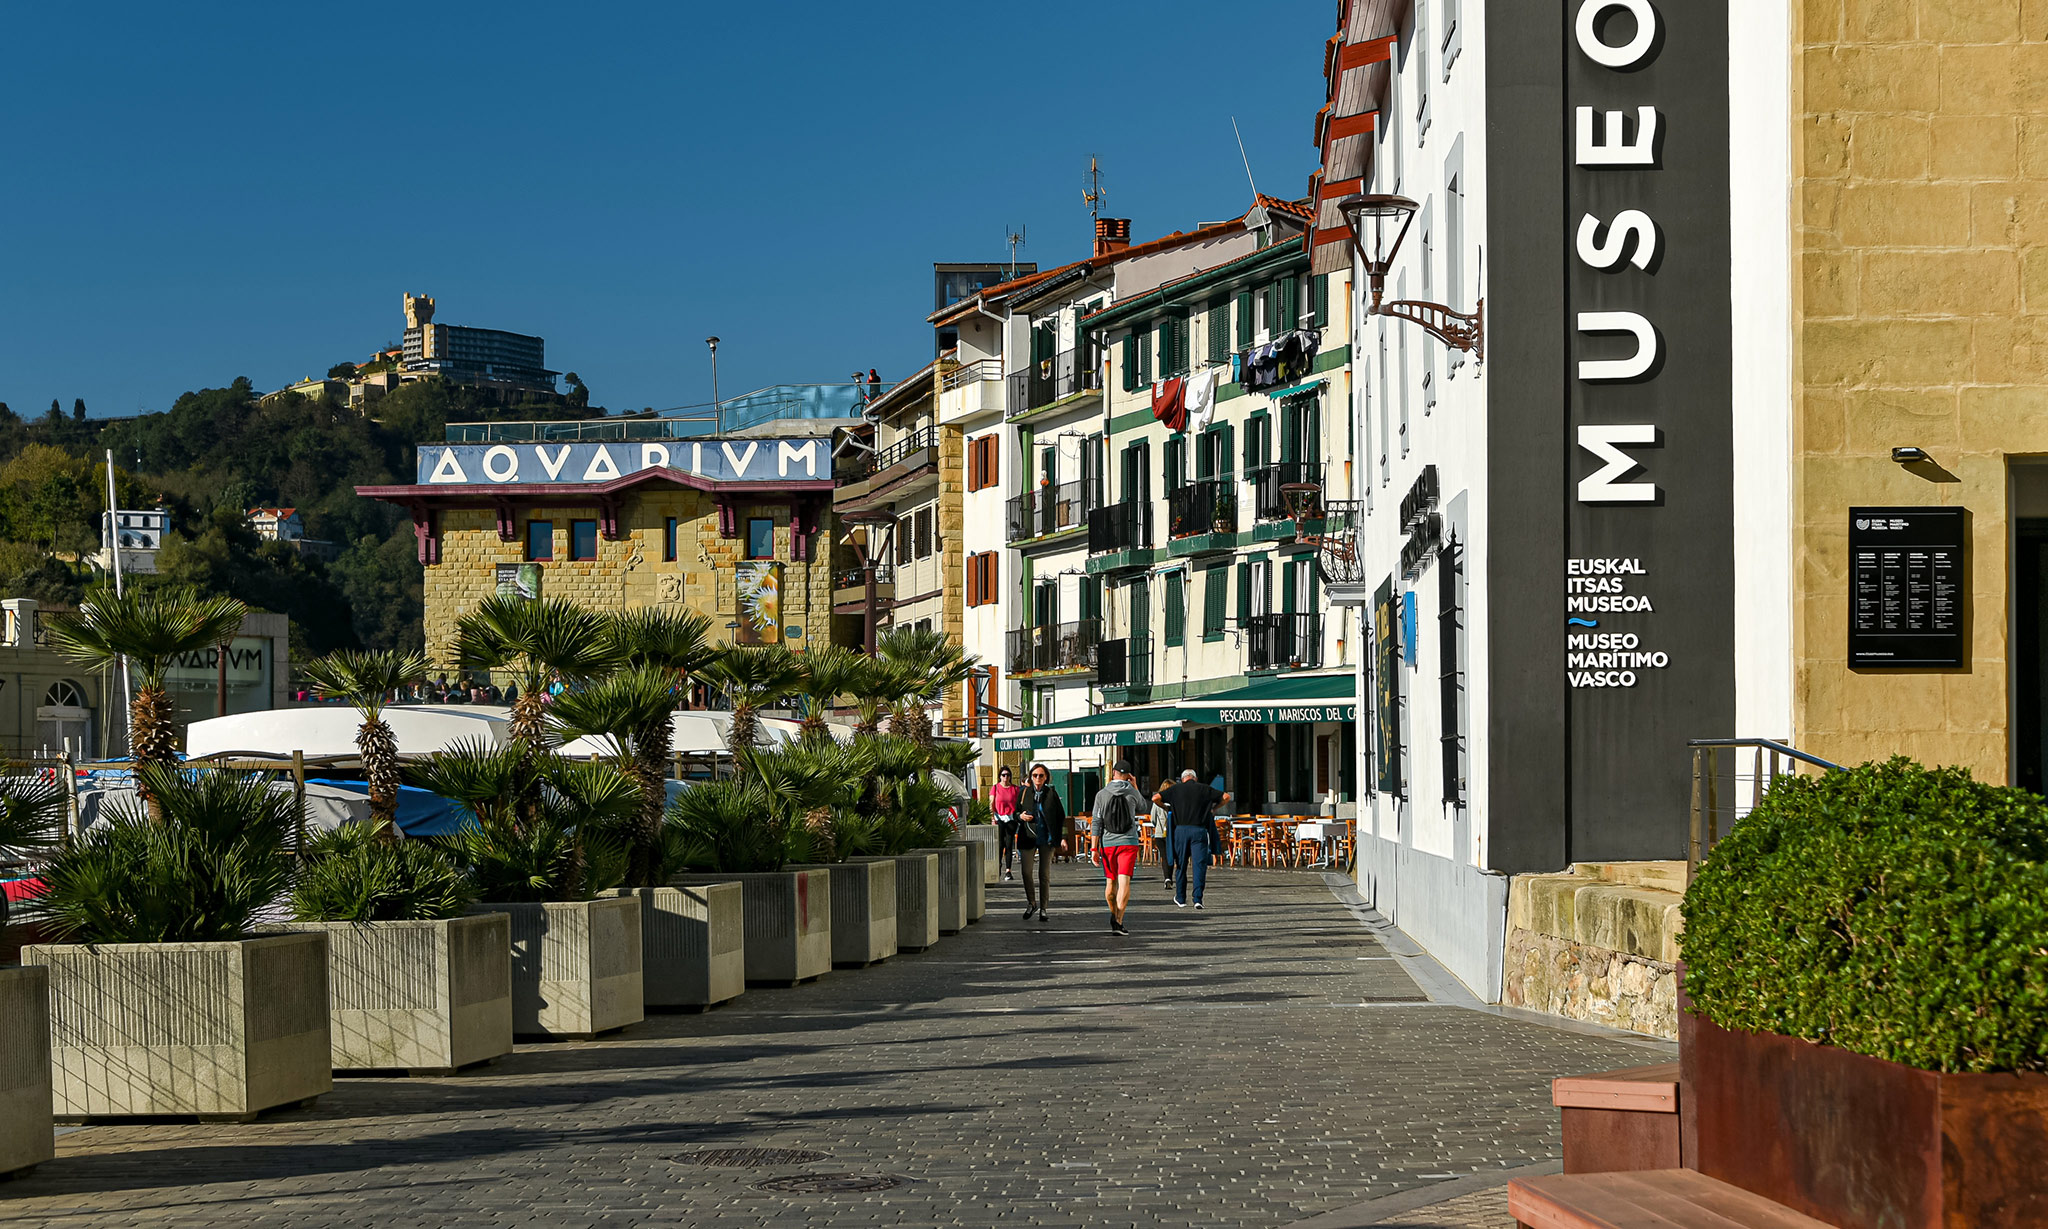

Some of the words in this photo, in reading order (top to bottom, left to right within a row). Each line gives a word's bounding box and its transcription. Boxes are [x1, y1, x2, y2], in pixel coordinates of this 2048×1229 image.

[1575, 0, 1656, 502] MUSEO
[1567, 558, 1646, 575] EUSKAL
[1567, 577, 1623, 593] ITSAS
[1567, 596, 1653, 612] MUSEOA
[1567, 633, 1639, 650] MUSEO
[1567, 649, 1669, 668] MARÍTIMO
[1567, 671, 1637, 687] VASCO
[1219, 709, 1262, 722] PESCADOS
[1267, 709, 1274, 721] Y
[1278, 708, 1322, 721] MARISCOS
[1326, 707, 1343, 721] DEL
[1081, 734, 1091, 746] LA
[1094, 733, 1118, 745] RAMPA
[1134, 730, 1162, 743] RESTAURANTE
[1165, 728, 1174, 742] BAR
